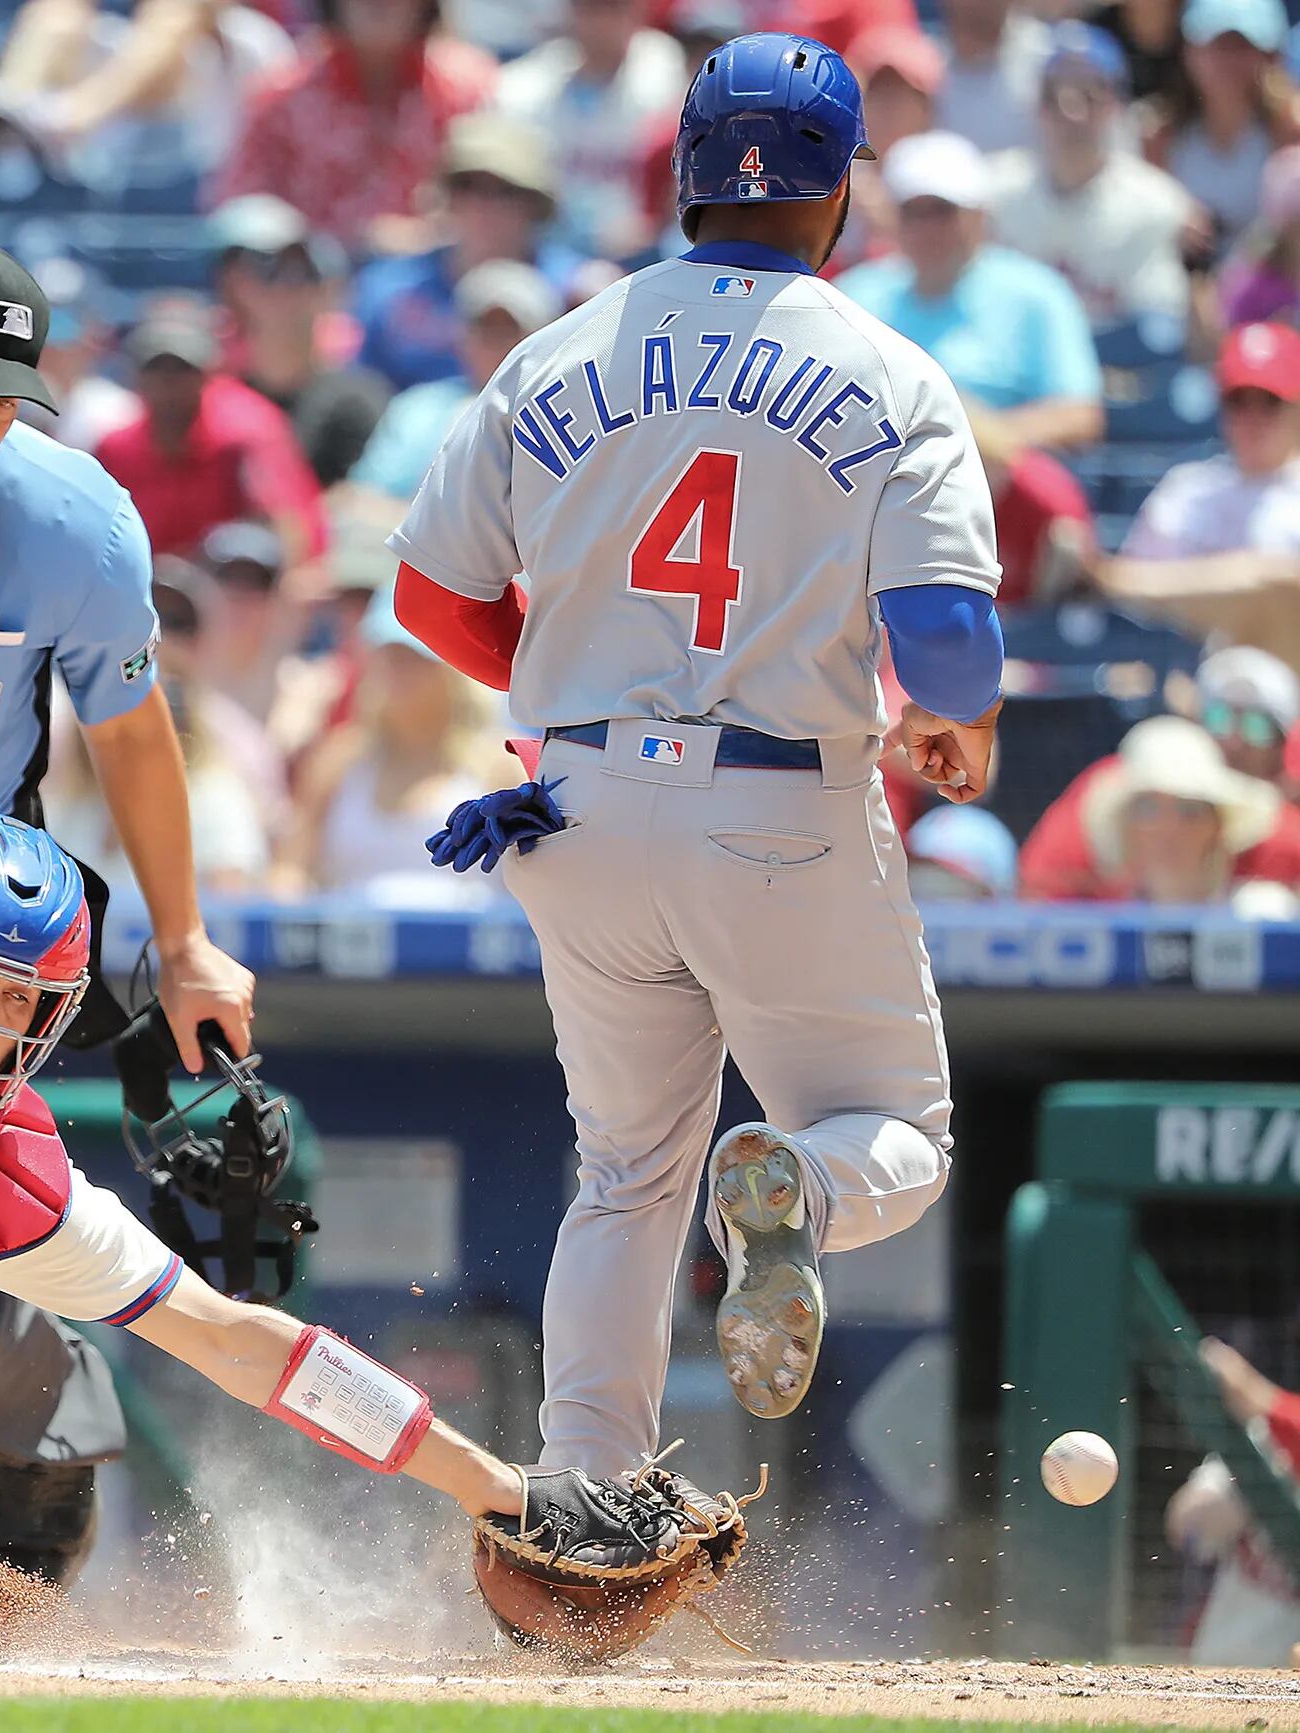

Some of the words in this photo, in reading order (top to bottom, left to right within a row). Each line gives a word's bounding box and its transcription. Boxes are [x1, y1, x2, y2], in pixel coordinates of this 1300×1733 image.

[740, 146, 764, 178] 4
[511, 310, 906, 498] VELÁZQUEZ
[627, 447, 744, 656] 4
[1156, 1106, 1300, 1185] RE/
[315, 1345, 353, 1377] Phillies
